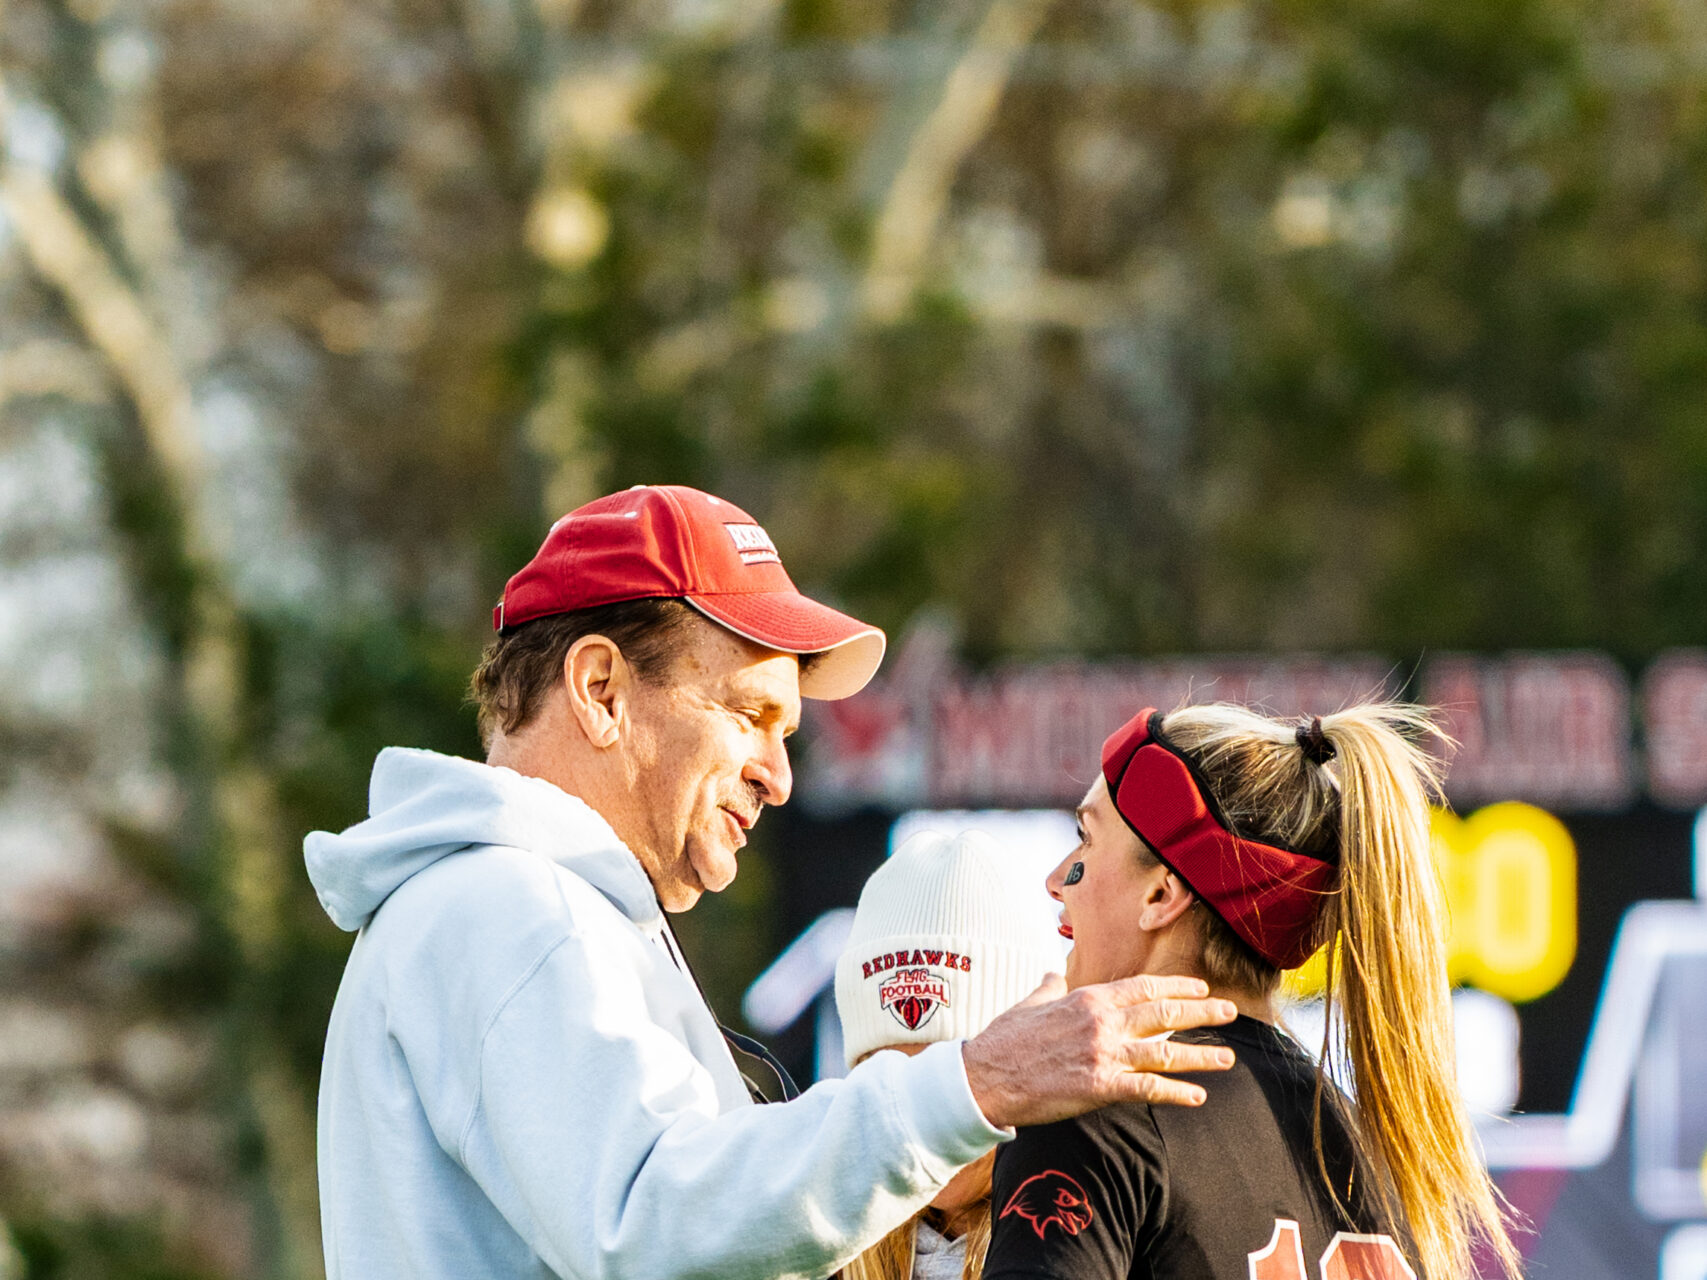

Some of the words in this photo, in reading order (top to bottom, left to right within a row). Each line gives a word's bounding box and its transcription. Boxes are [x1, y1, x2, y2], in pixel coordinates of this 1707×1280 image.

[862, 949, 971, 980] REDHAWKS
[896, 970, 928, 984] FLAG
[881, 984, 948, 1005] FOOTBALL
